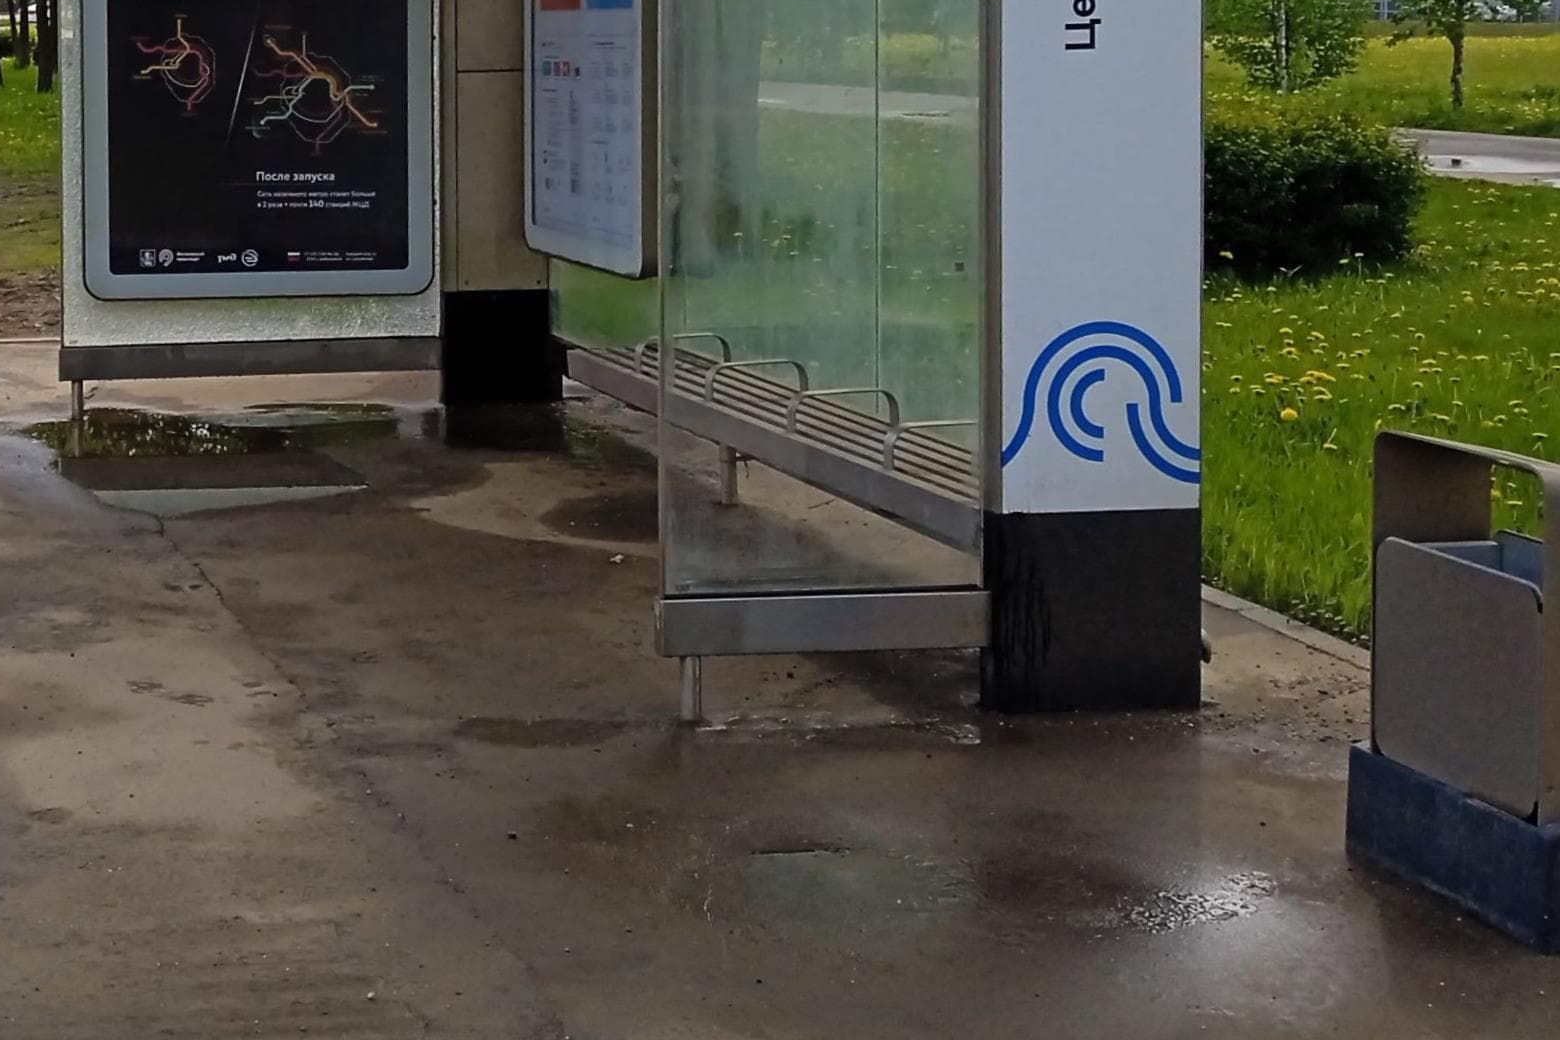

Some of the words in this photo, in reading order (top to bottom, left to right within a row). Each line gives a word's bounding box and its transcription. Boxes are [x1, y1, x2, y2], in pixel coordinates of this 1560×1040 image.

[256, 171, 290, 182] После
[292, 173, 336, 184] запуска
[309, 200, 324, 208] 140
